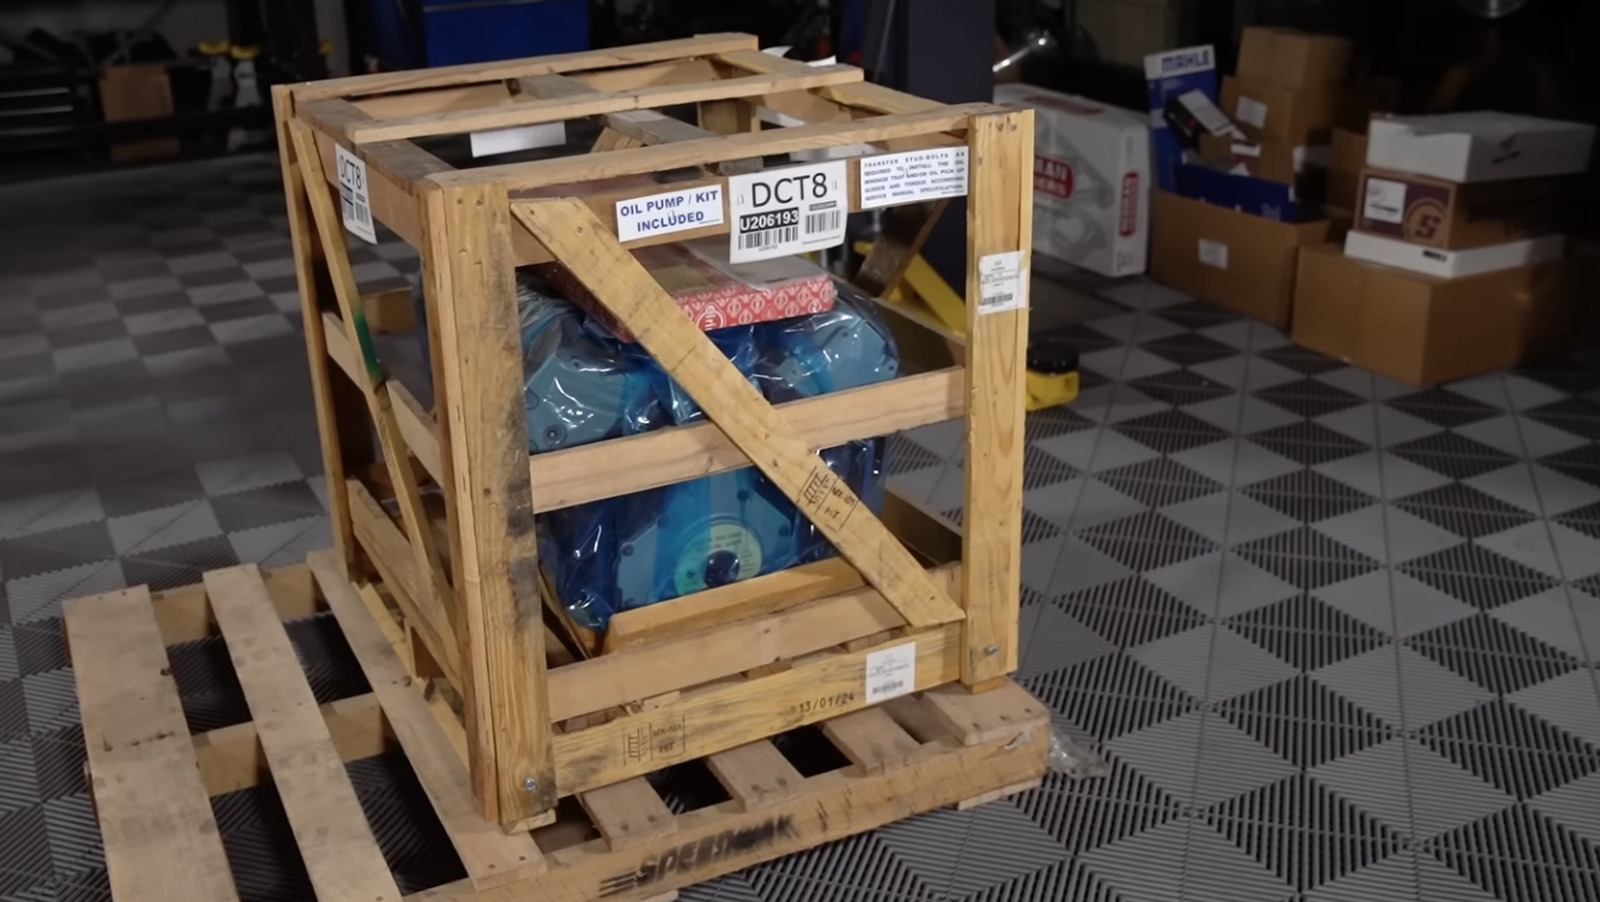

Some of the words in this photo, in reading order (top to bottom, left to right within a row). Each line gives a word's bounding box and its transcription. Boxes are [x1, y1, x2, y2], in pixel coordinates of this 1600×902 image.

[1161, 50, 1209, 74] MAHLE
[339, 154, 363, 190] DCT8
[864, 159, 899, 168] TRANSFER
[864, 168, 892, 177] REQUIRED
[752, 172, 828, 208] DCT8
[620, 203, 643, 218] OIL
[646, 195, 685, 212] PUMP
[687, 194, 692, 205] /
[695, 189, 719, 204] KIT
[637, 210, 705, 232] INCLUDED
[740, 208, 800, 232] U206193
[799, 691, 855, 713] 13/01/24
